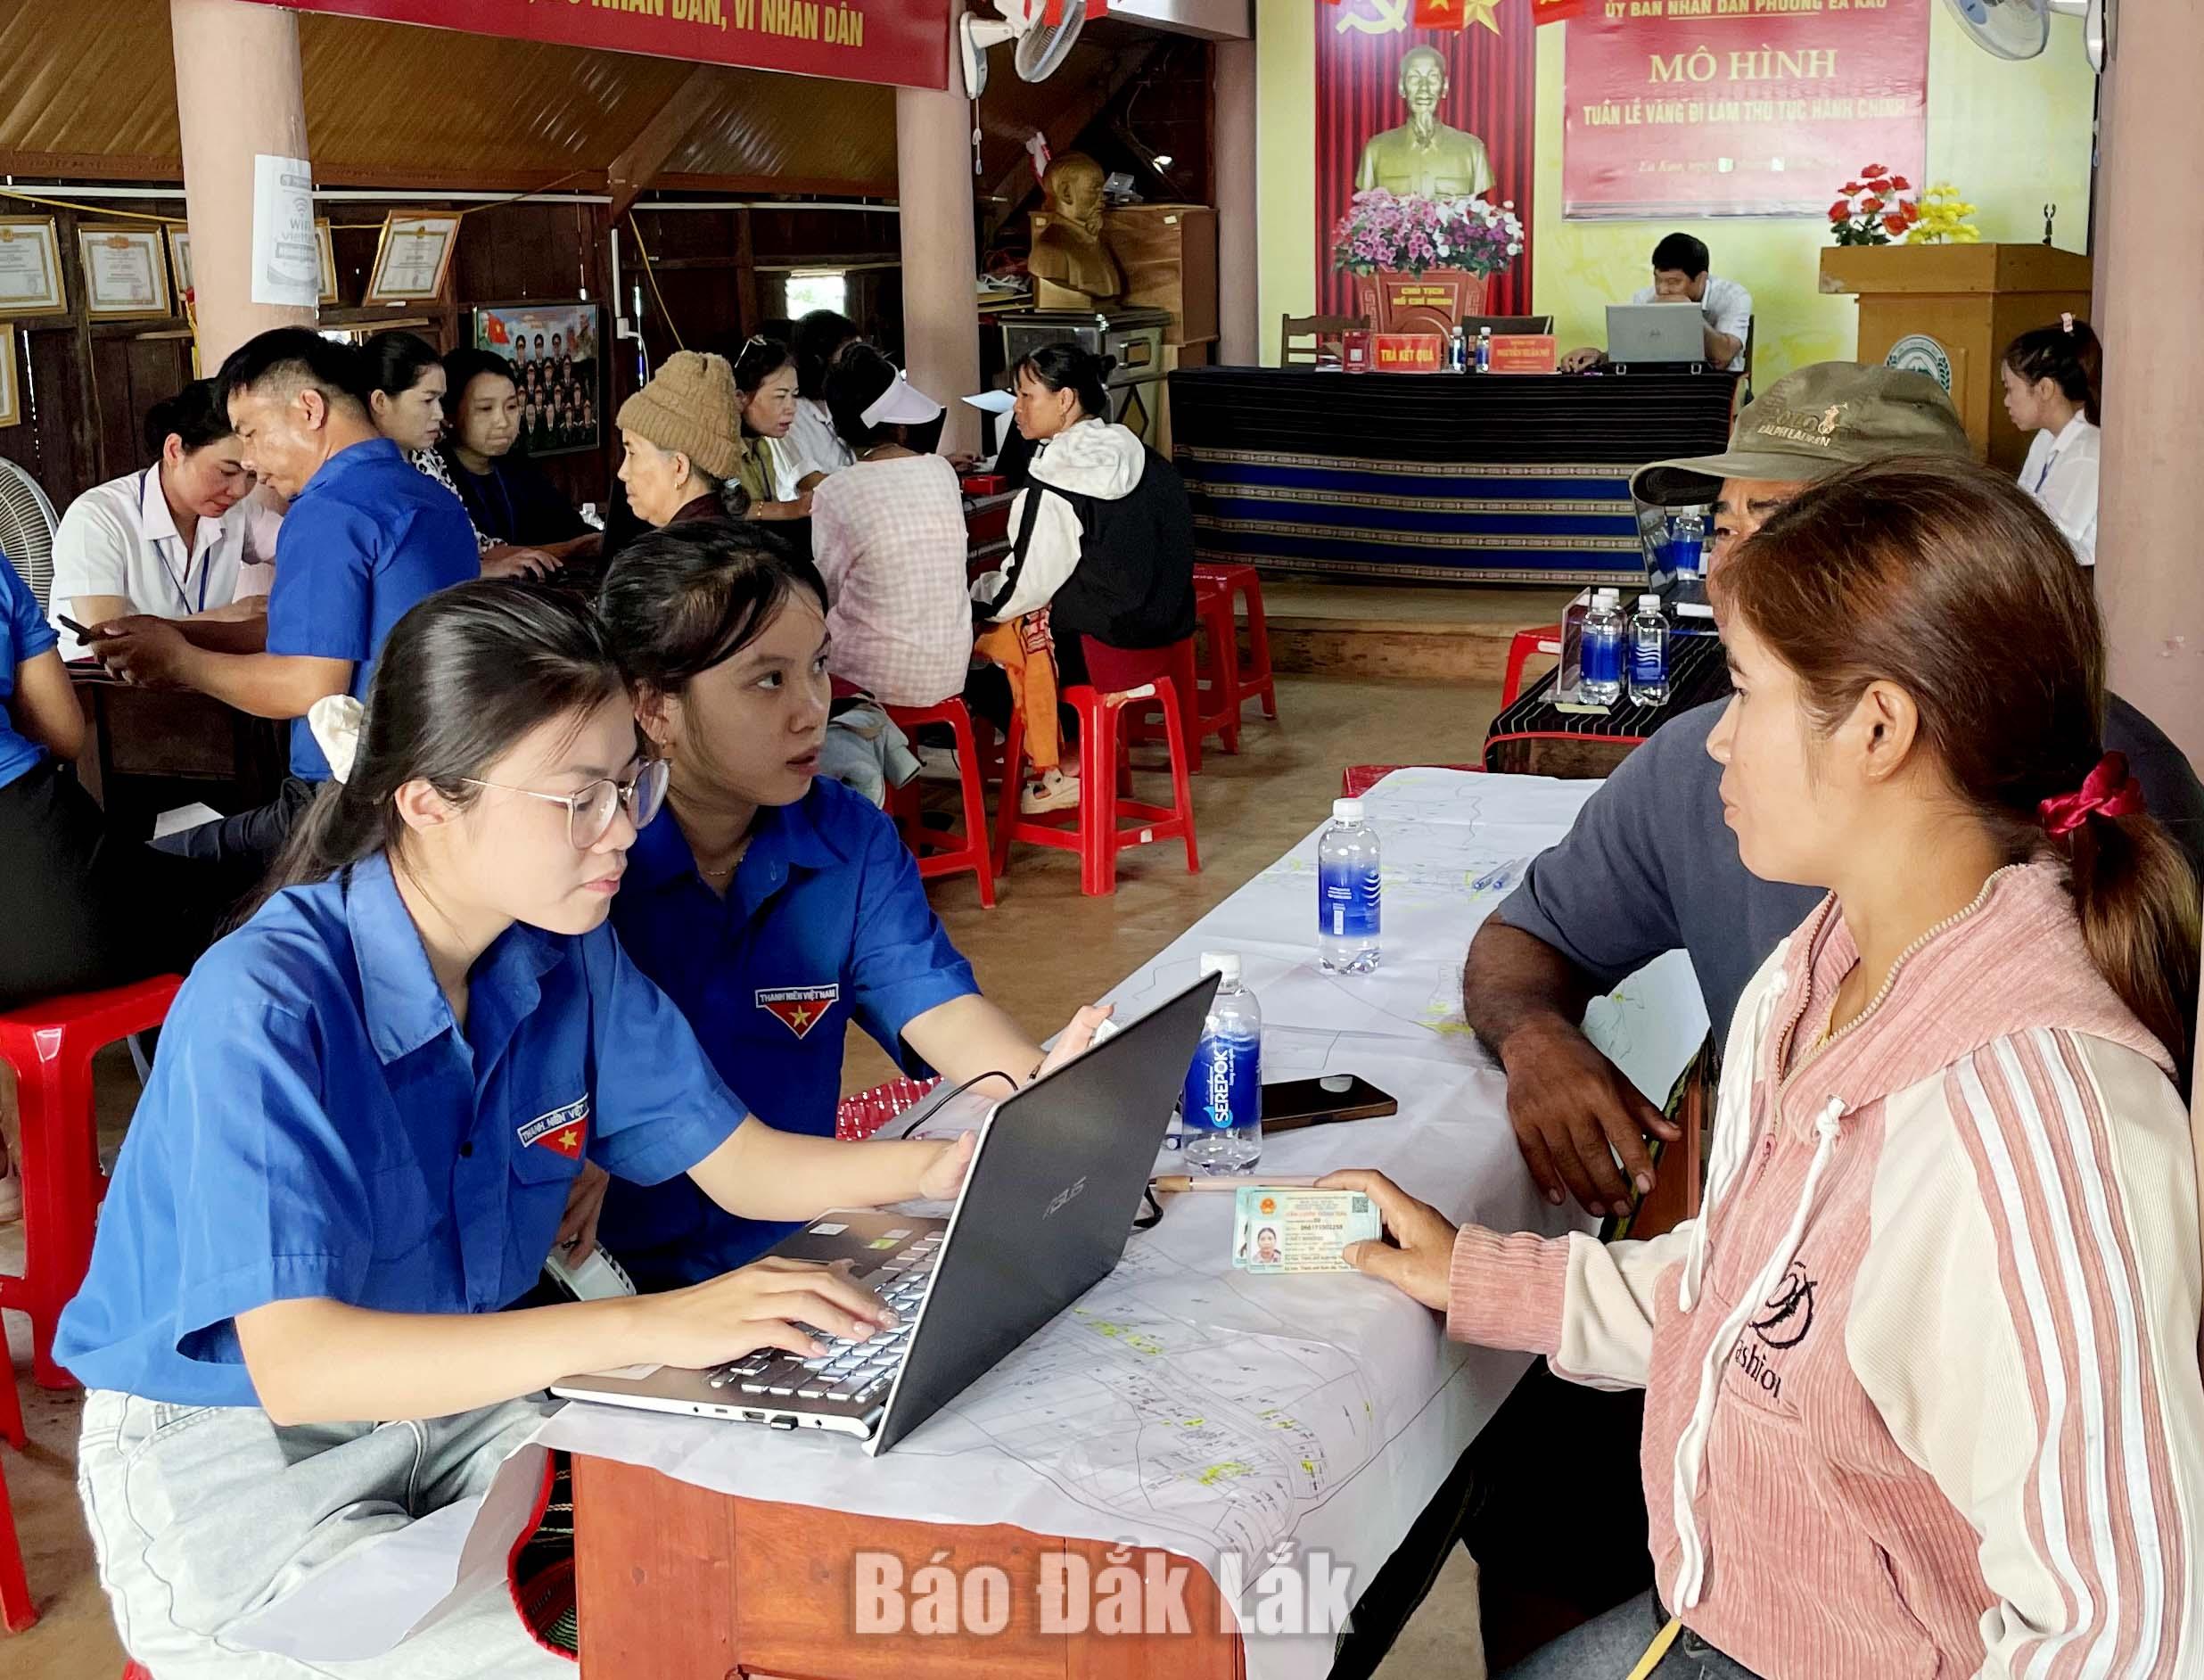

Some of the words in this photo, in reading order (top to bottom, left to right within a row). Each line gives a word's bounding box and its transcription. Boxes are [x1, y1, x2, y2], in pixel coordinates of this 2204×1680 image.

[824, 1, 863, 47] DÂN
[1630, 2, 1662, 17] BAN
[1649, 45, 1717, 83] MÔ
[1728, 44, 1838, 80] HÌNH
[1213, 1049, 1229, 1123] SEREPOK
